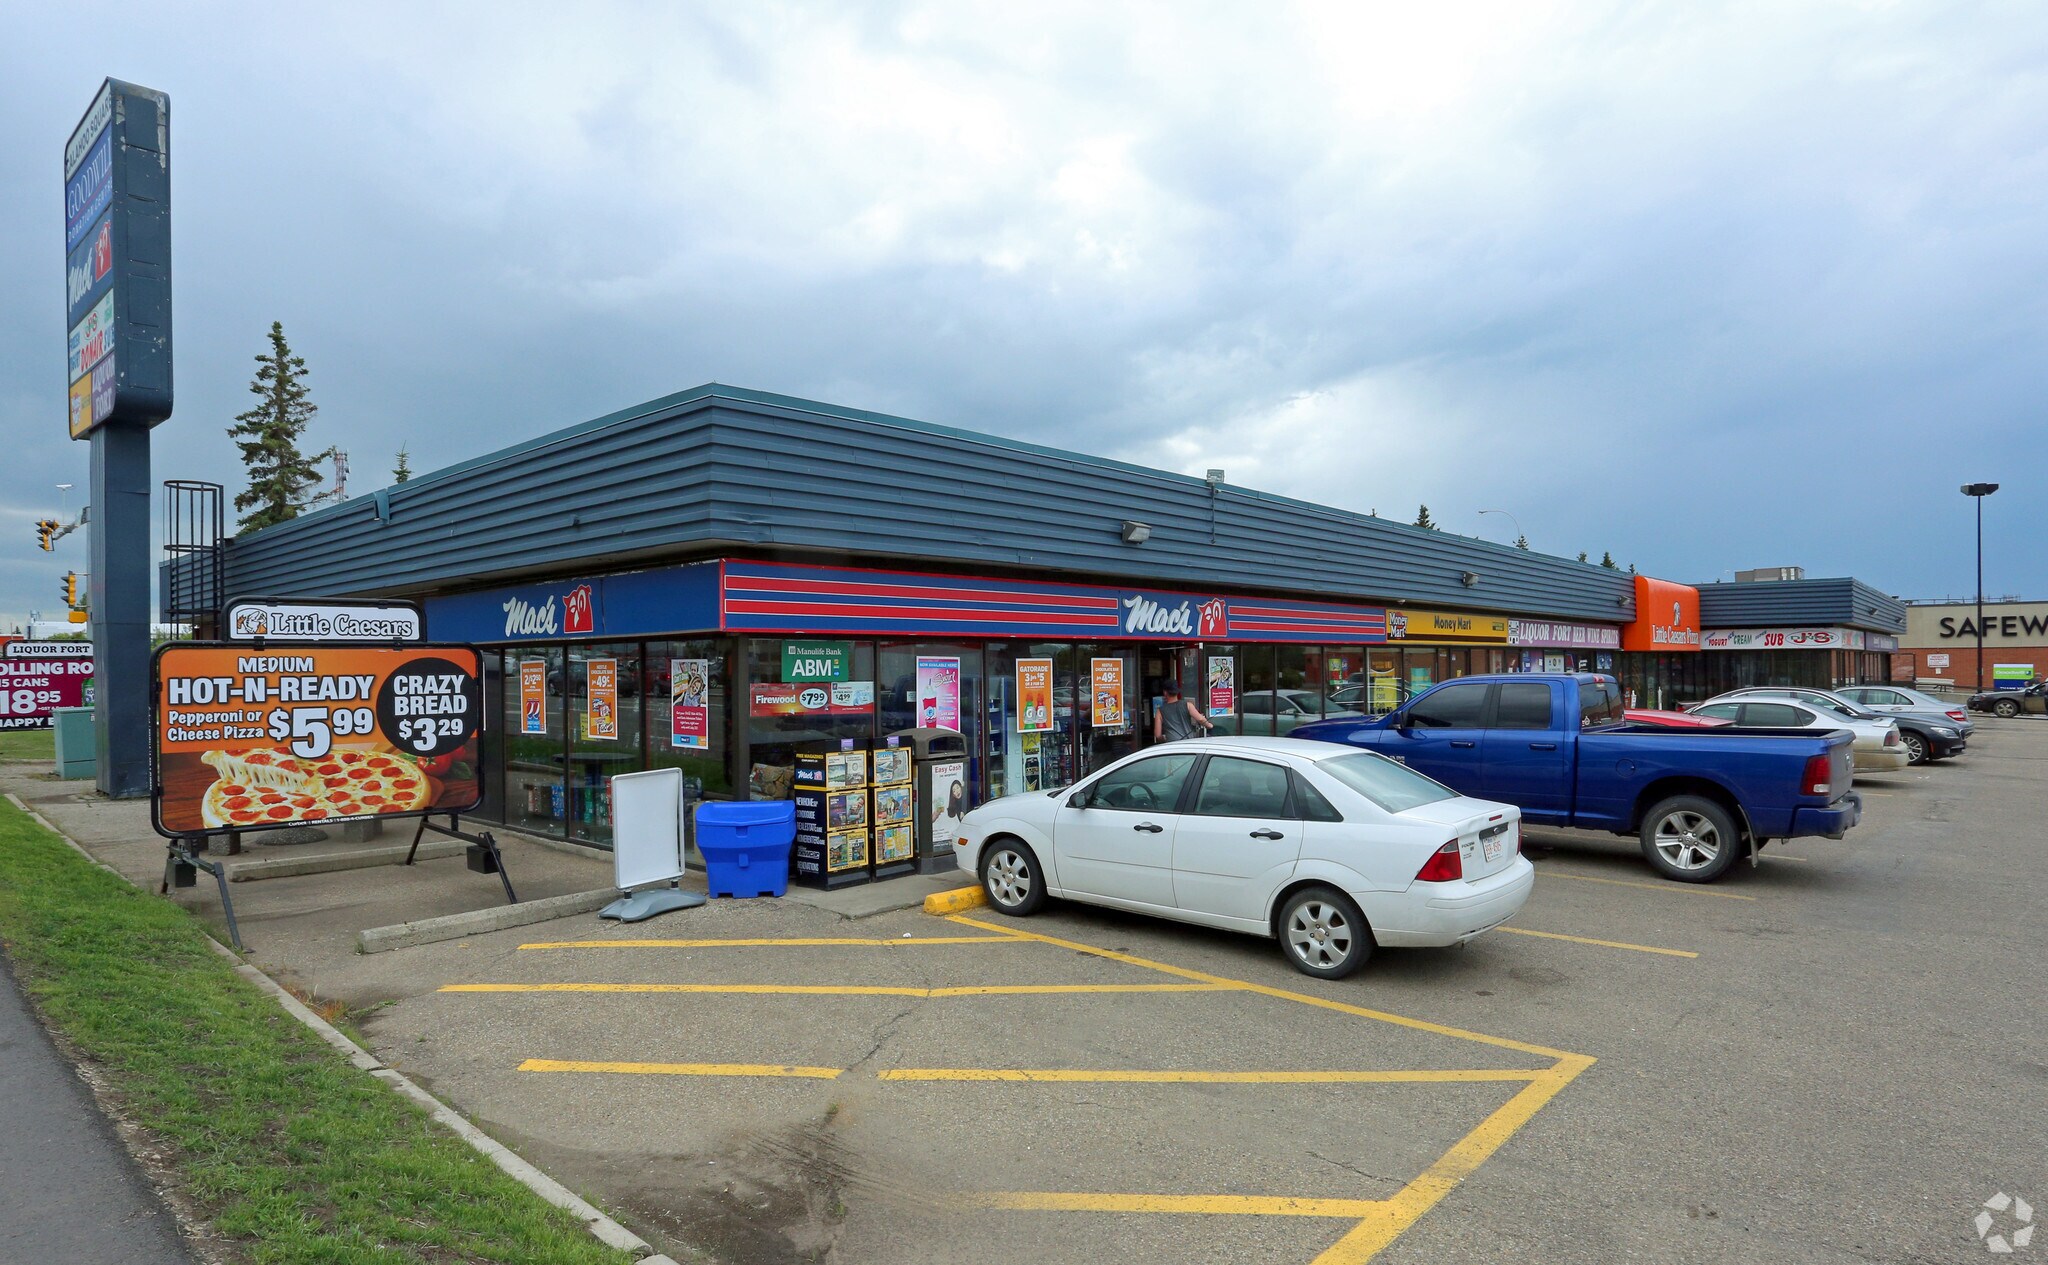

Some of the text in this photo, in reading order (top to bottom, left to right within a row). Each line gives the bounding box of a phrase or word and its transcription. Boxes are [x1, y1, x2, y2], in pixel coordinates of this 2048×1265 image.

[68, 135, 112, 219] GOODWILL
[503, 595, 558, 637] Mac's
[1122, 595, 1193, 635] Mac's
[1389, 612, 1408, 626] Money
[1434, 615, 1472, 632] Money Mart
[271, 612, 414, 638] Little Caesars
[1390, 626, 1407, 638] Mart
[1520, 623, 1550, 644] LIQUOR
[1552, 624, 1571, 642] FORT
[1940, 615, 2048, 638] SAFEW
[1708, 638, 1728, 646] YOGURT
[1733, 634, 1752, 645] CREAM
[1764, 633, 1784, 647] SUB
[13, 645, 89, 654] LIQUOR FORT
[796, 647, 842, 656] Manulife Bank
[0, 662, 94, 676] OLLING RO
[237, 656, 314, 674] MEDIUM
[791, 659, 832, 677] ABM
[13, 678, 49, 687] CANS
[393, 675, 465, 695] CRAZY
[1025, 673, 1029, 682] 3
[168, 675, 375, 705] HOT-N-READY
[393, 694, 467, 716] BREAD
[755, 695, 796, 704] Firewood
[168, 709, 262, 726] Pepperoni or
[167, 725, 265, 742] Cheese Pizza
